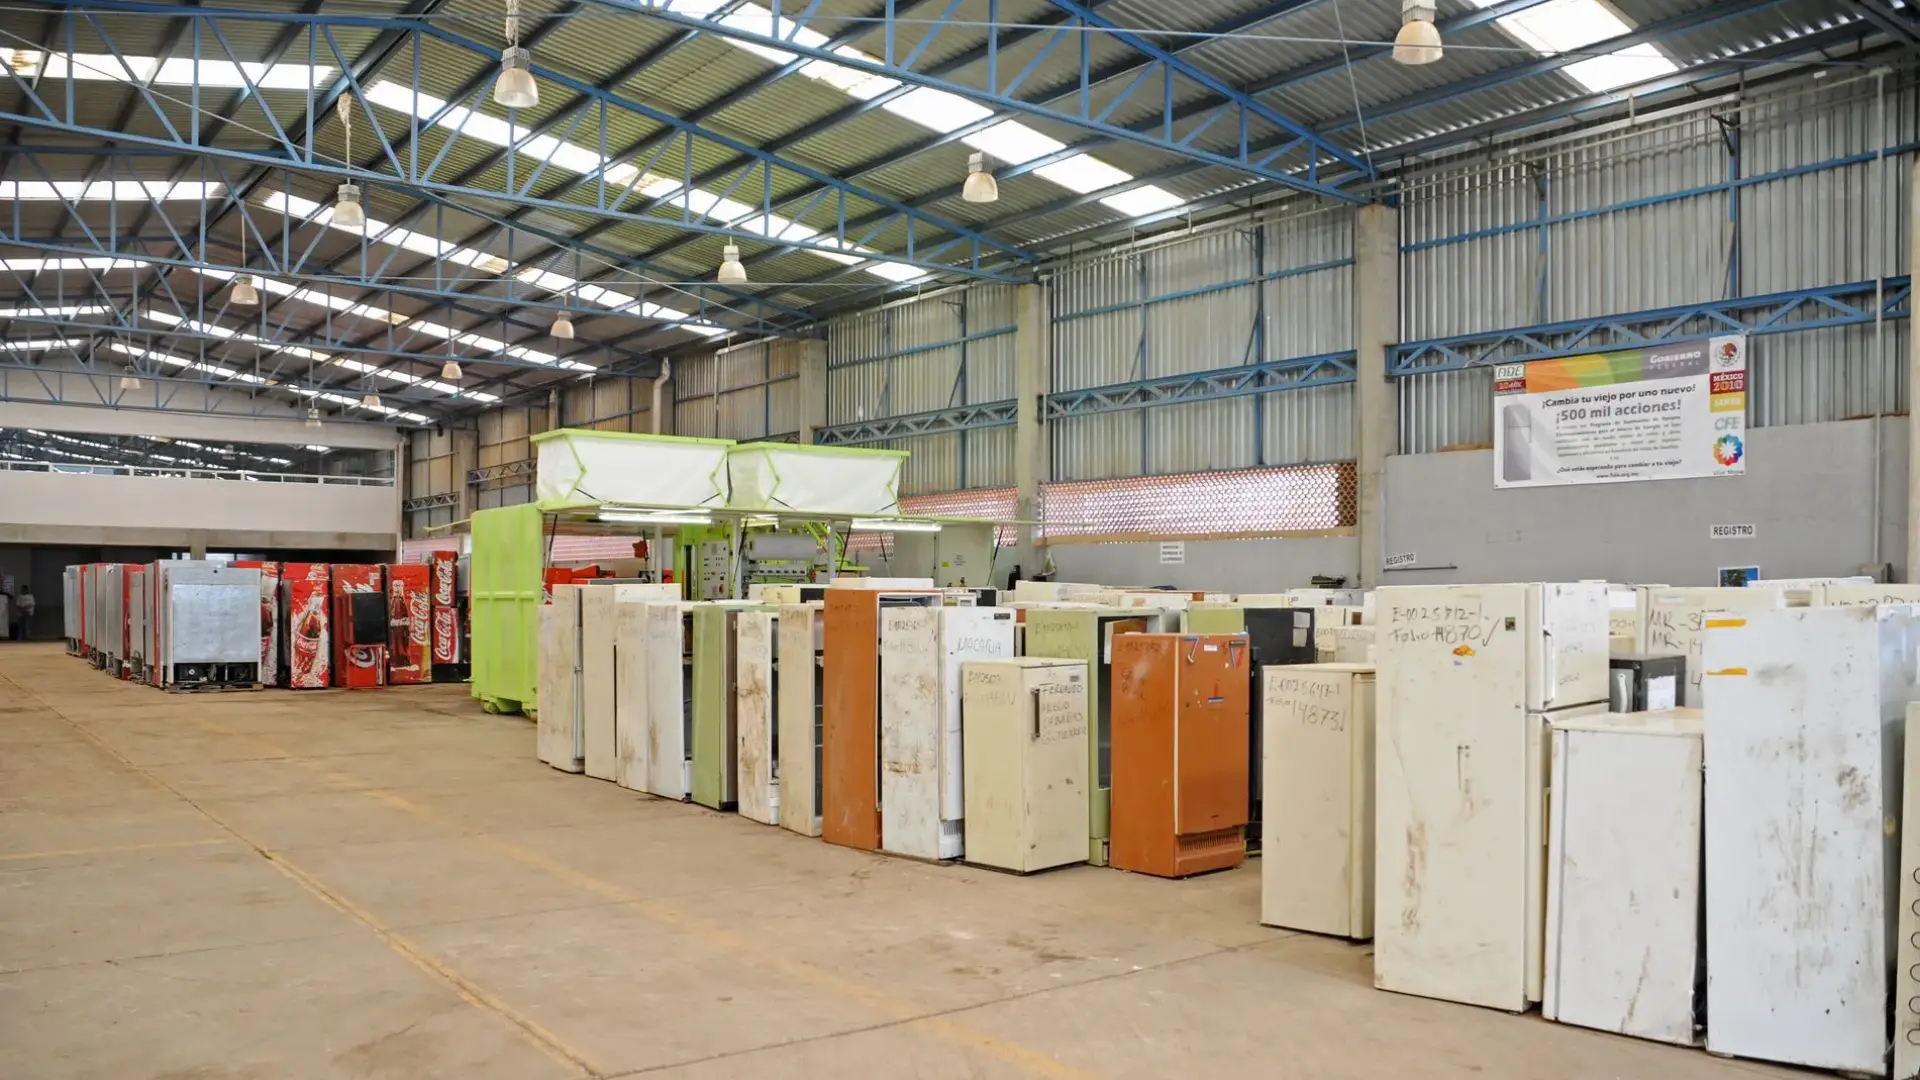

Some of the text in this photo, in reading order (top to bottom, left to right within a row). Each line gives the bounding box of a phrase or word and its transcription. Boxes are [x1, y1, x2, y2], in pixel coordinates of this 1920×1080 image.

[1650, 350, 1701, 364] GOBIERNO
[1713, 372, 1744, 382] MÉXICO
[1713, 379, 1744, 392] 2010
[1542, 397, 1579, 409] ¡Cambia
[1594, 392, 1617, 403] viejo
[1619, 391, 1636, 402] por
[1638, 389, 1658, 398] uno
[1660, 384, 1697, 396] nuevo!
[1556, 399, 1682, 424] ¡500 mil acciones!
[1714, 416, 1741, 431] CFE
[1713, 525, 1754, 536] REGISTRO
[1386, 553, 1415, 565] REGISTRO
